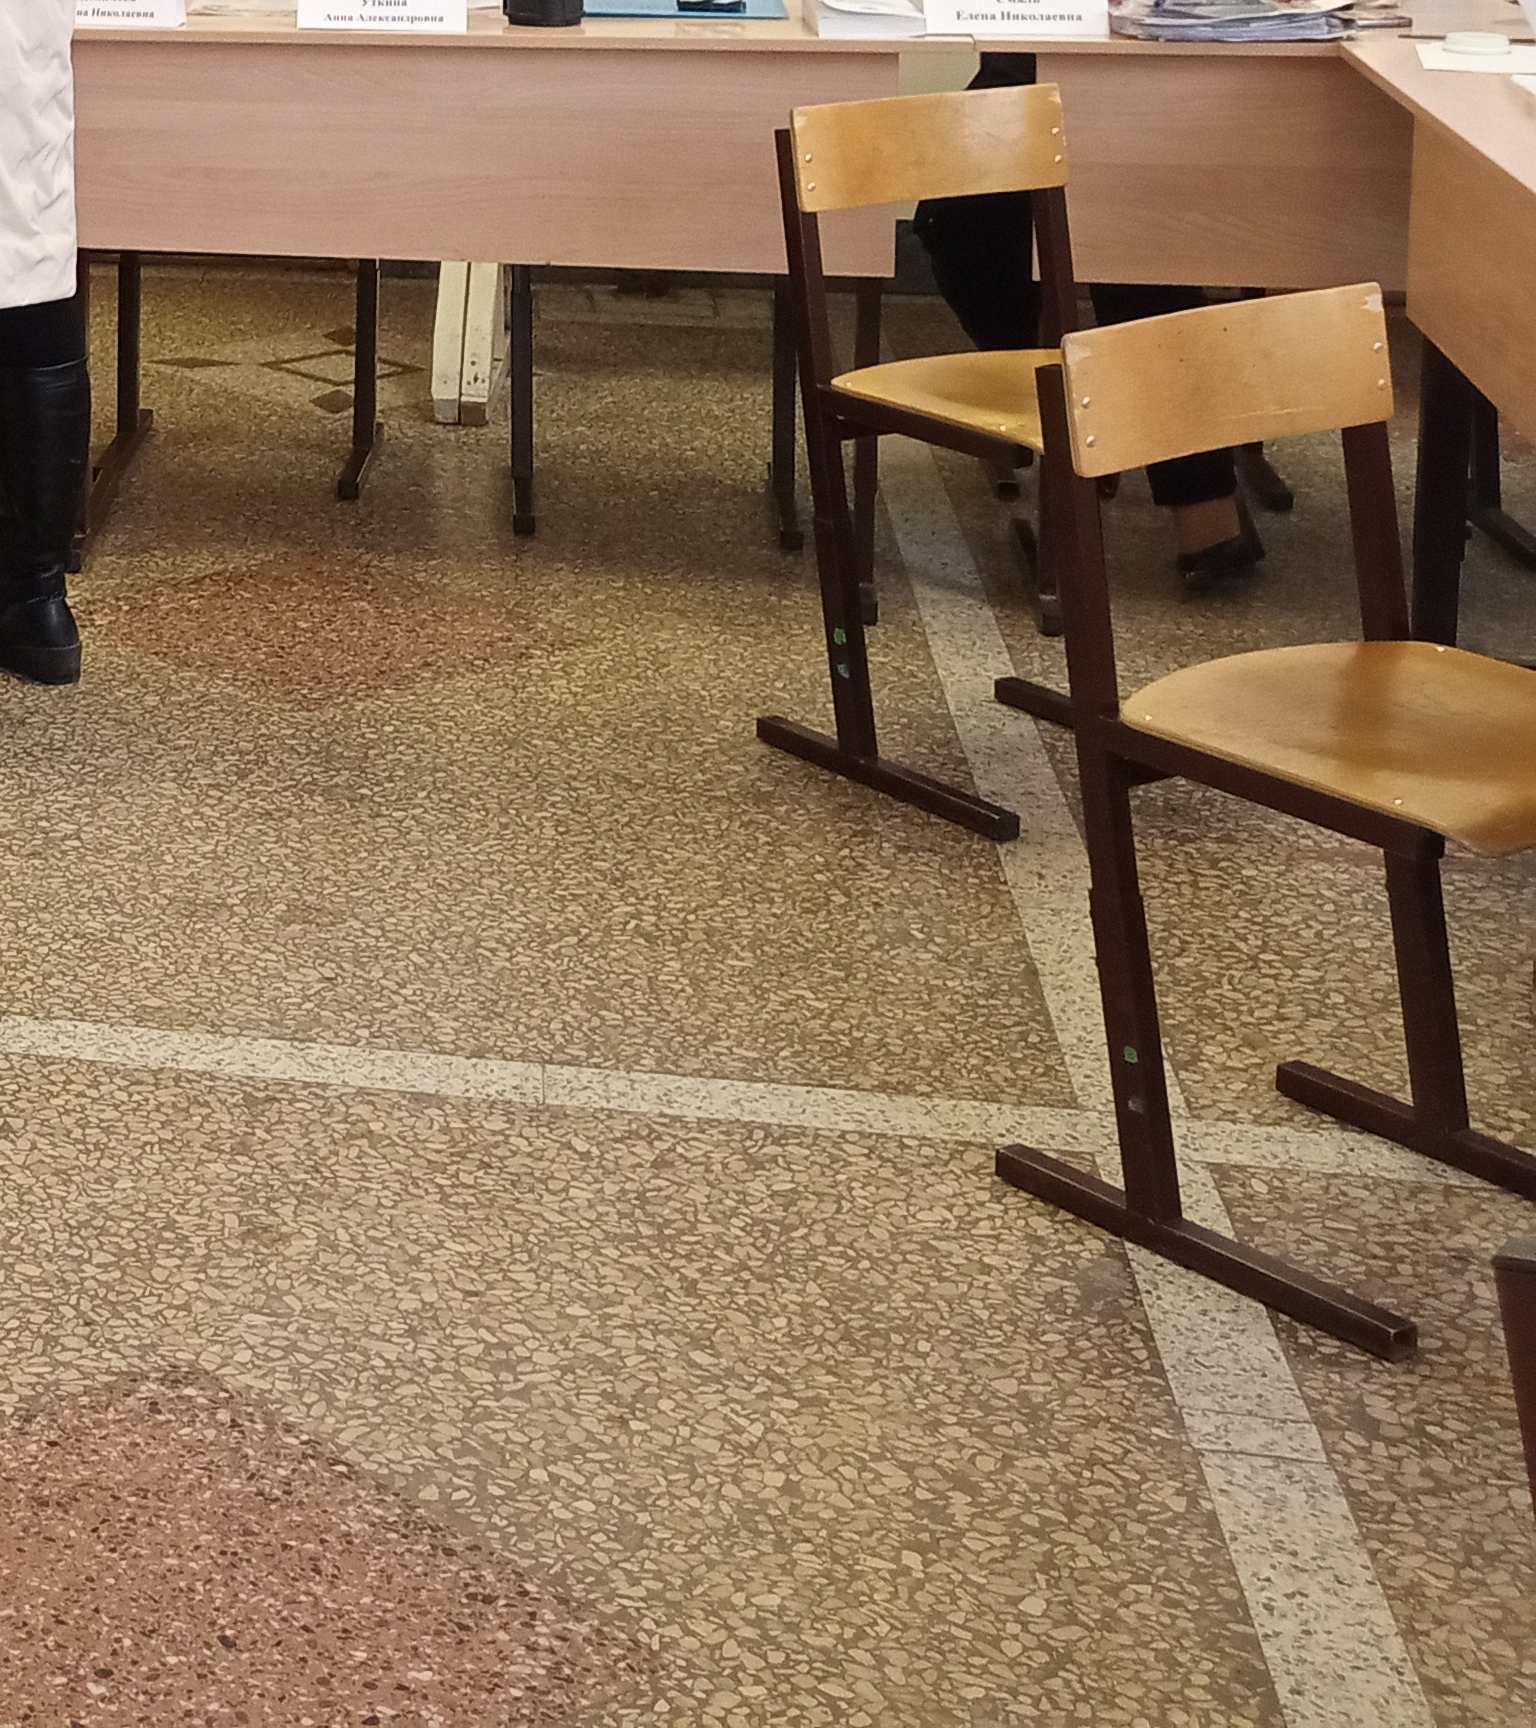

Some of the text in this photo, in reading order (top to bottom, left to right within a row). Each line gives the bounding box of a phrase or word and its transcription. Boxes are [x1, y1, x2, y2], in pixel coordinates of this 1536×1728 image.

[91, 8, 155, 18] Николаевна
[324, 13, 444, 24] Анна Александровна
[956, 10, 1083, 22] Елена Николаевна
